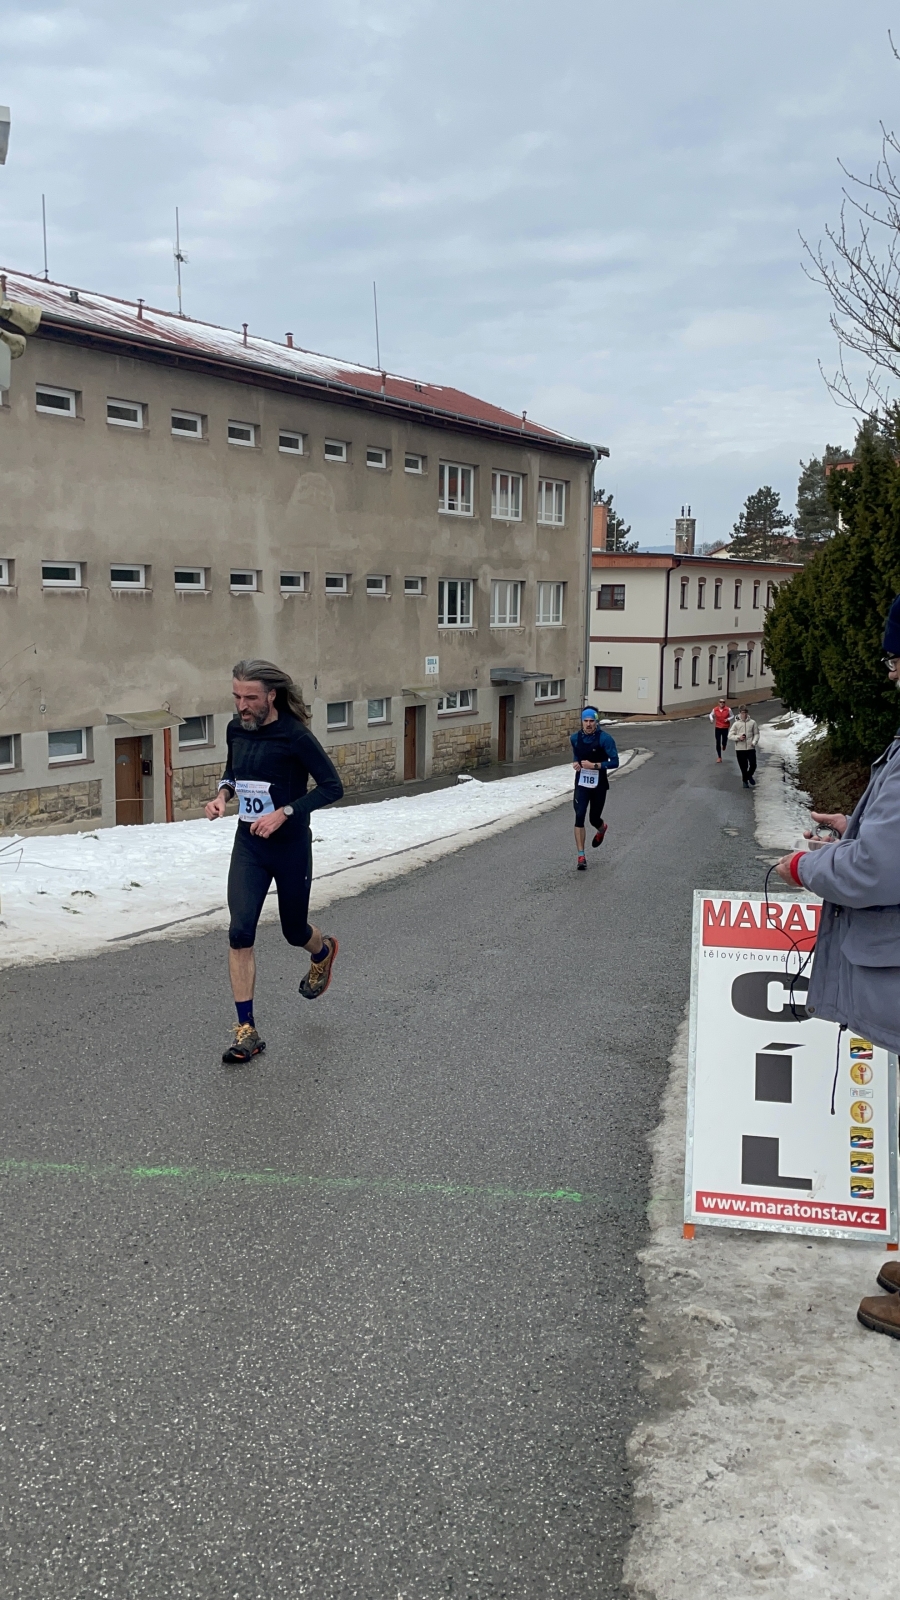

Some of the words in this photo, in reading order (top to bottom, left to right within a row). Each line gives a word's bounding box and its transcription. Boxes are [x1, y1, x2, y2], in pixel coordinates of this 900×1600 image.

[583, 776, 595, 784] 118
[244, 797, 264, 814] 30
[703, 950, 787, 963] tělovýchovná
[702, 1197, 880, 1224] www.maratonstav.cz
